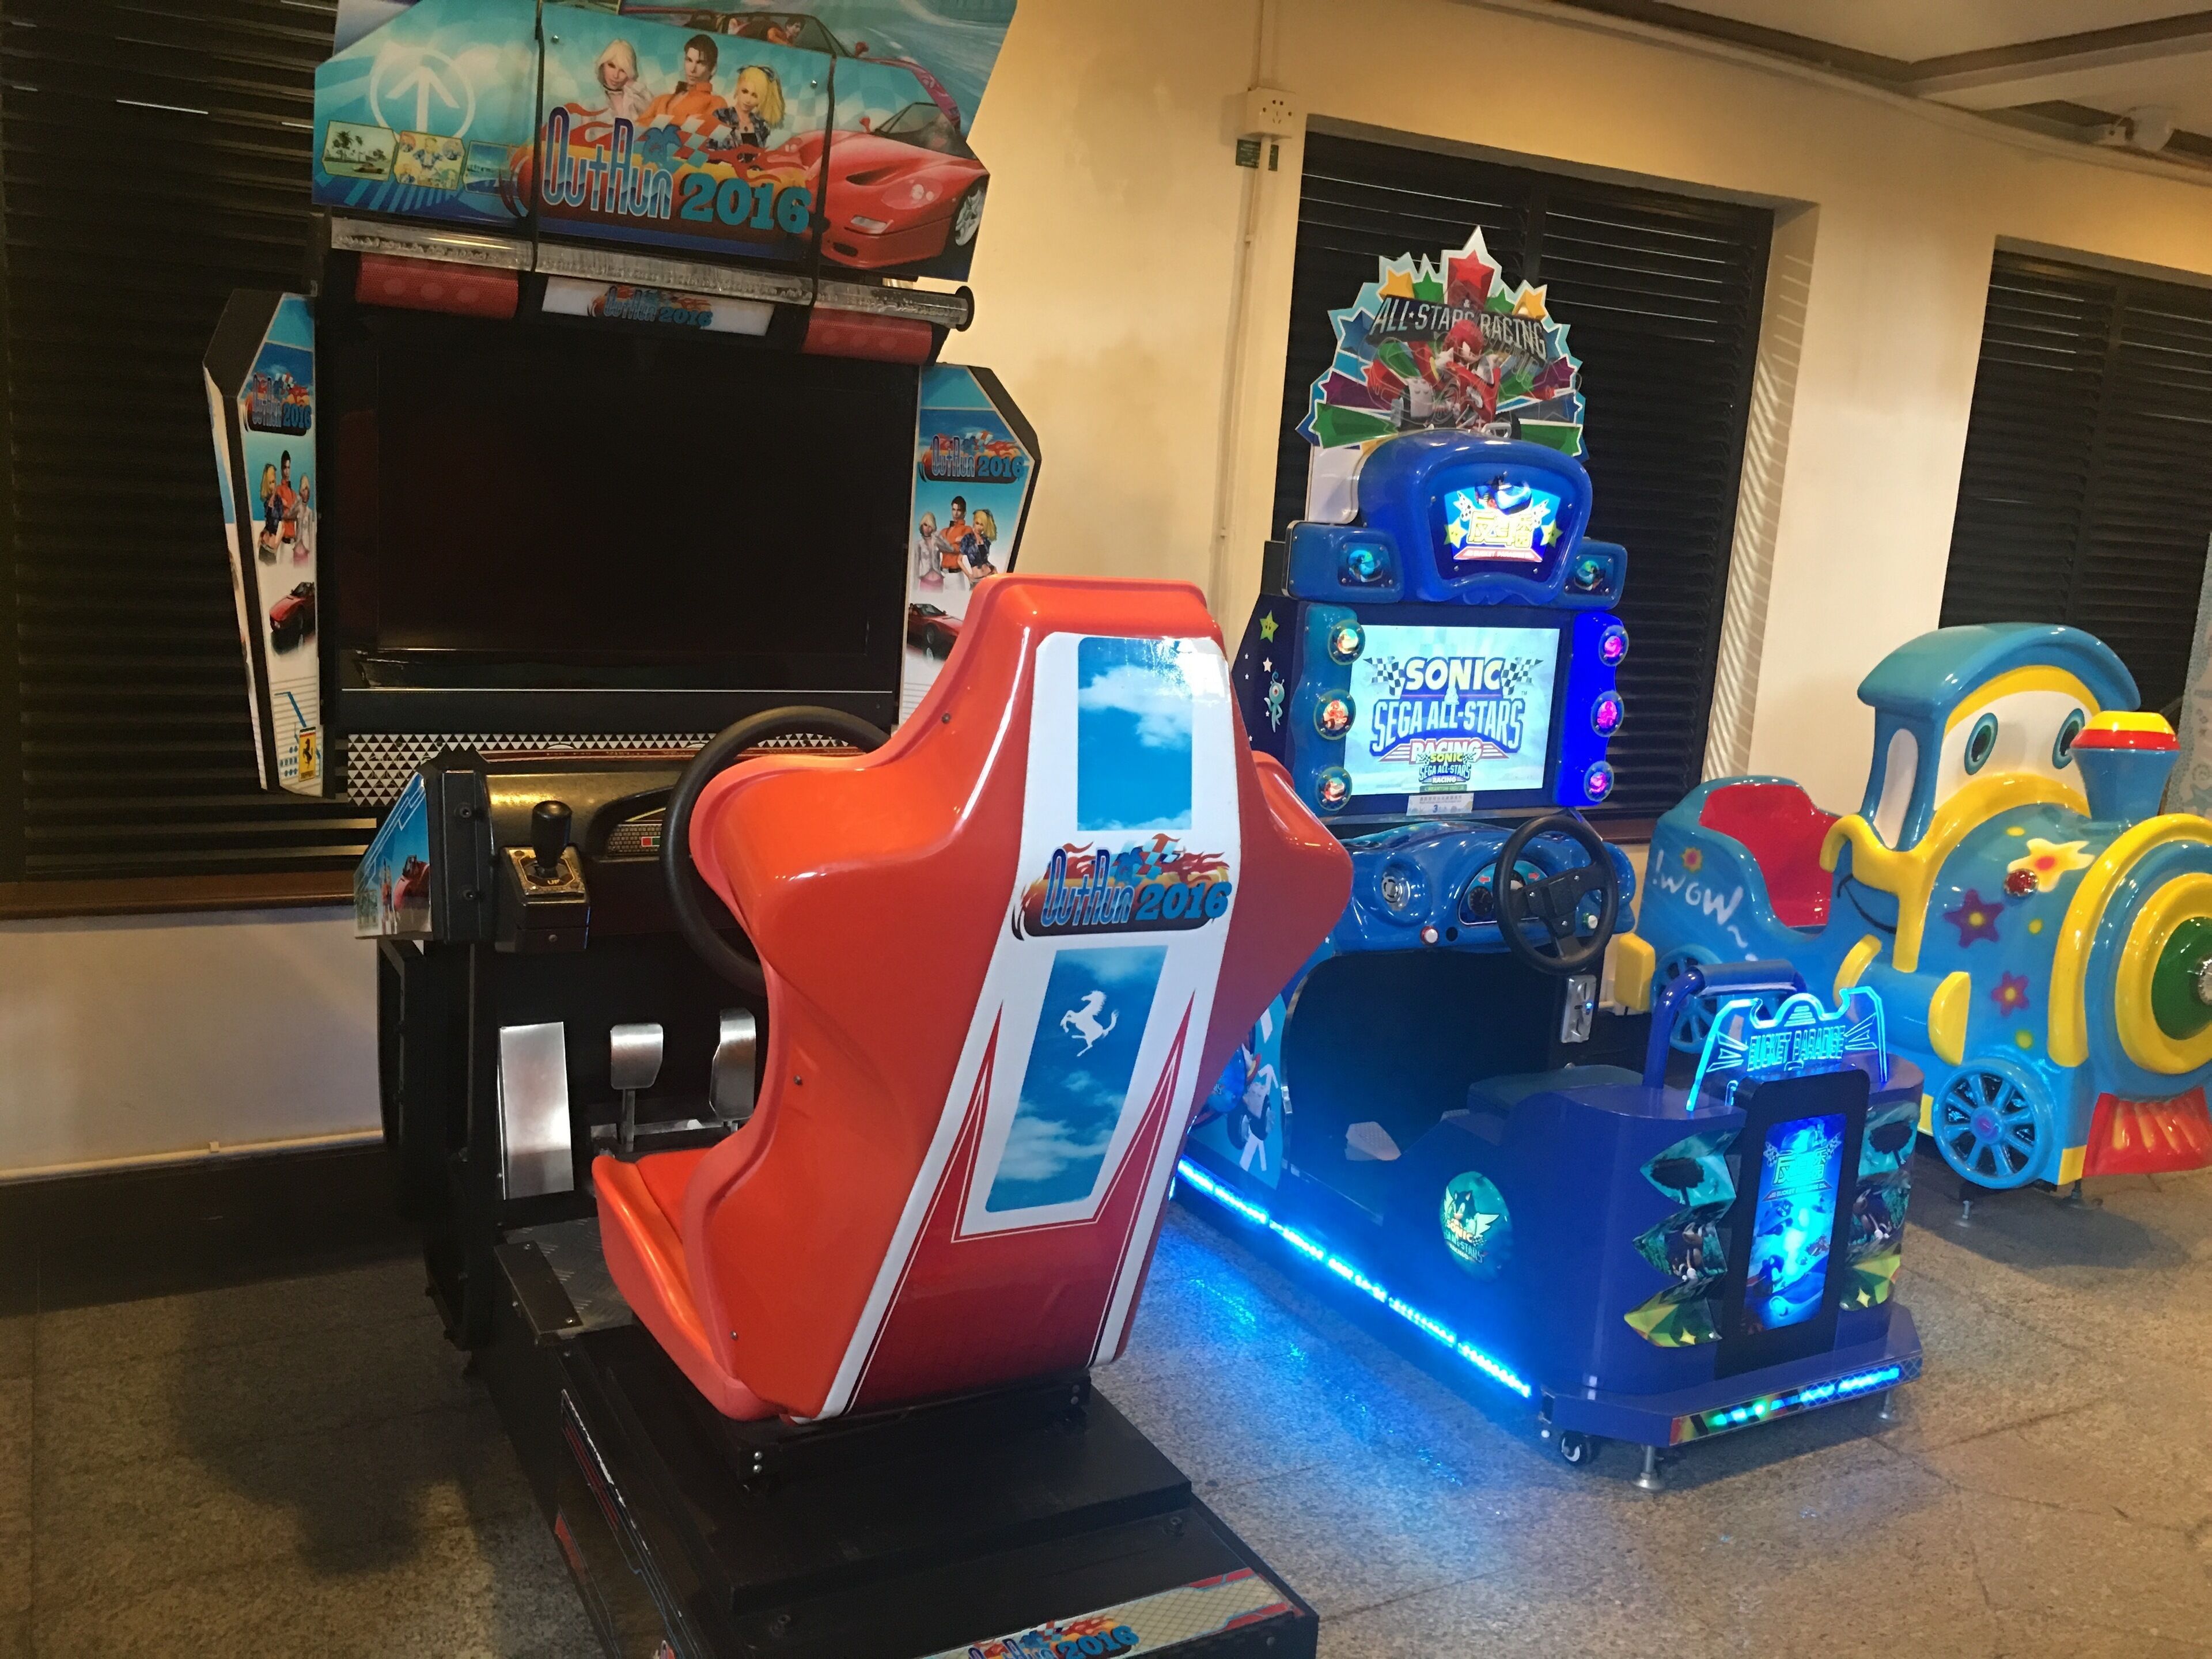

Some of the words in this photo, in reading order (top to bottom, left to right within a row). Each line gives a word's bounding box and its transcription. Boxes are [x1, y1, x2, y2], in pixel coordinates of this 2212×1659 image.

[679, 172, 812, 234] 2016
[658, 306, 714, 327] 2016
[283, 402, 312, 430] 2016
[977, 455, 1025, 479] 2016
[1405, 658, 1503, 691] SONIC
[1371, 699, 1423, 753] SEGA
[1426, 699, 1522, 749] ALL-STARS
[1419, 764, 1437, 781] SEGA
[1437, 764, 1471, 779] ALL-STARS
[1430, 752, 1464, 763] SONIC
[1433, 804, 1438, 813] 3
[1135, 881, 1232, 922] 2016
[1746, 1031, 1793, 1071] BUCKET
[1793, 1025, 1846, 1062] PARADISE
[1057, 1625, 1139, 1659] 2016
